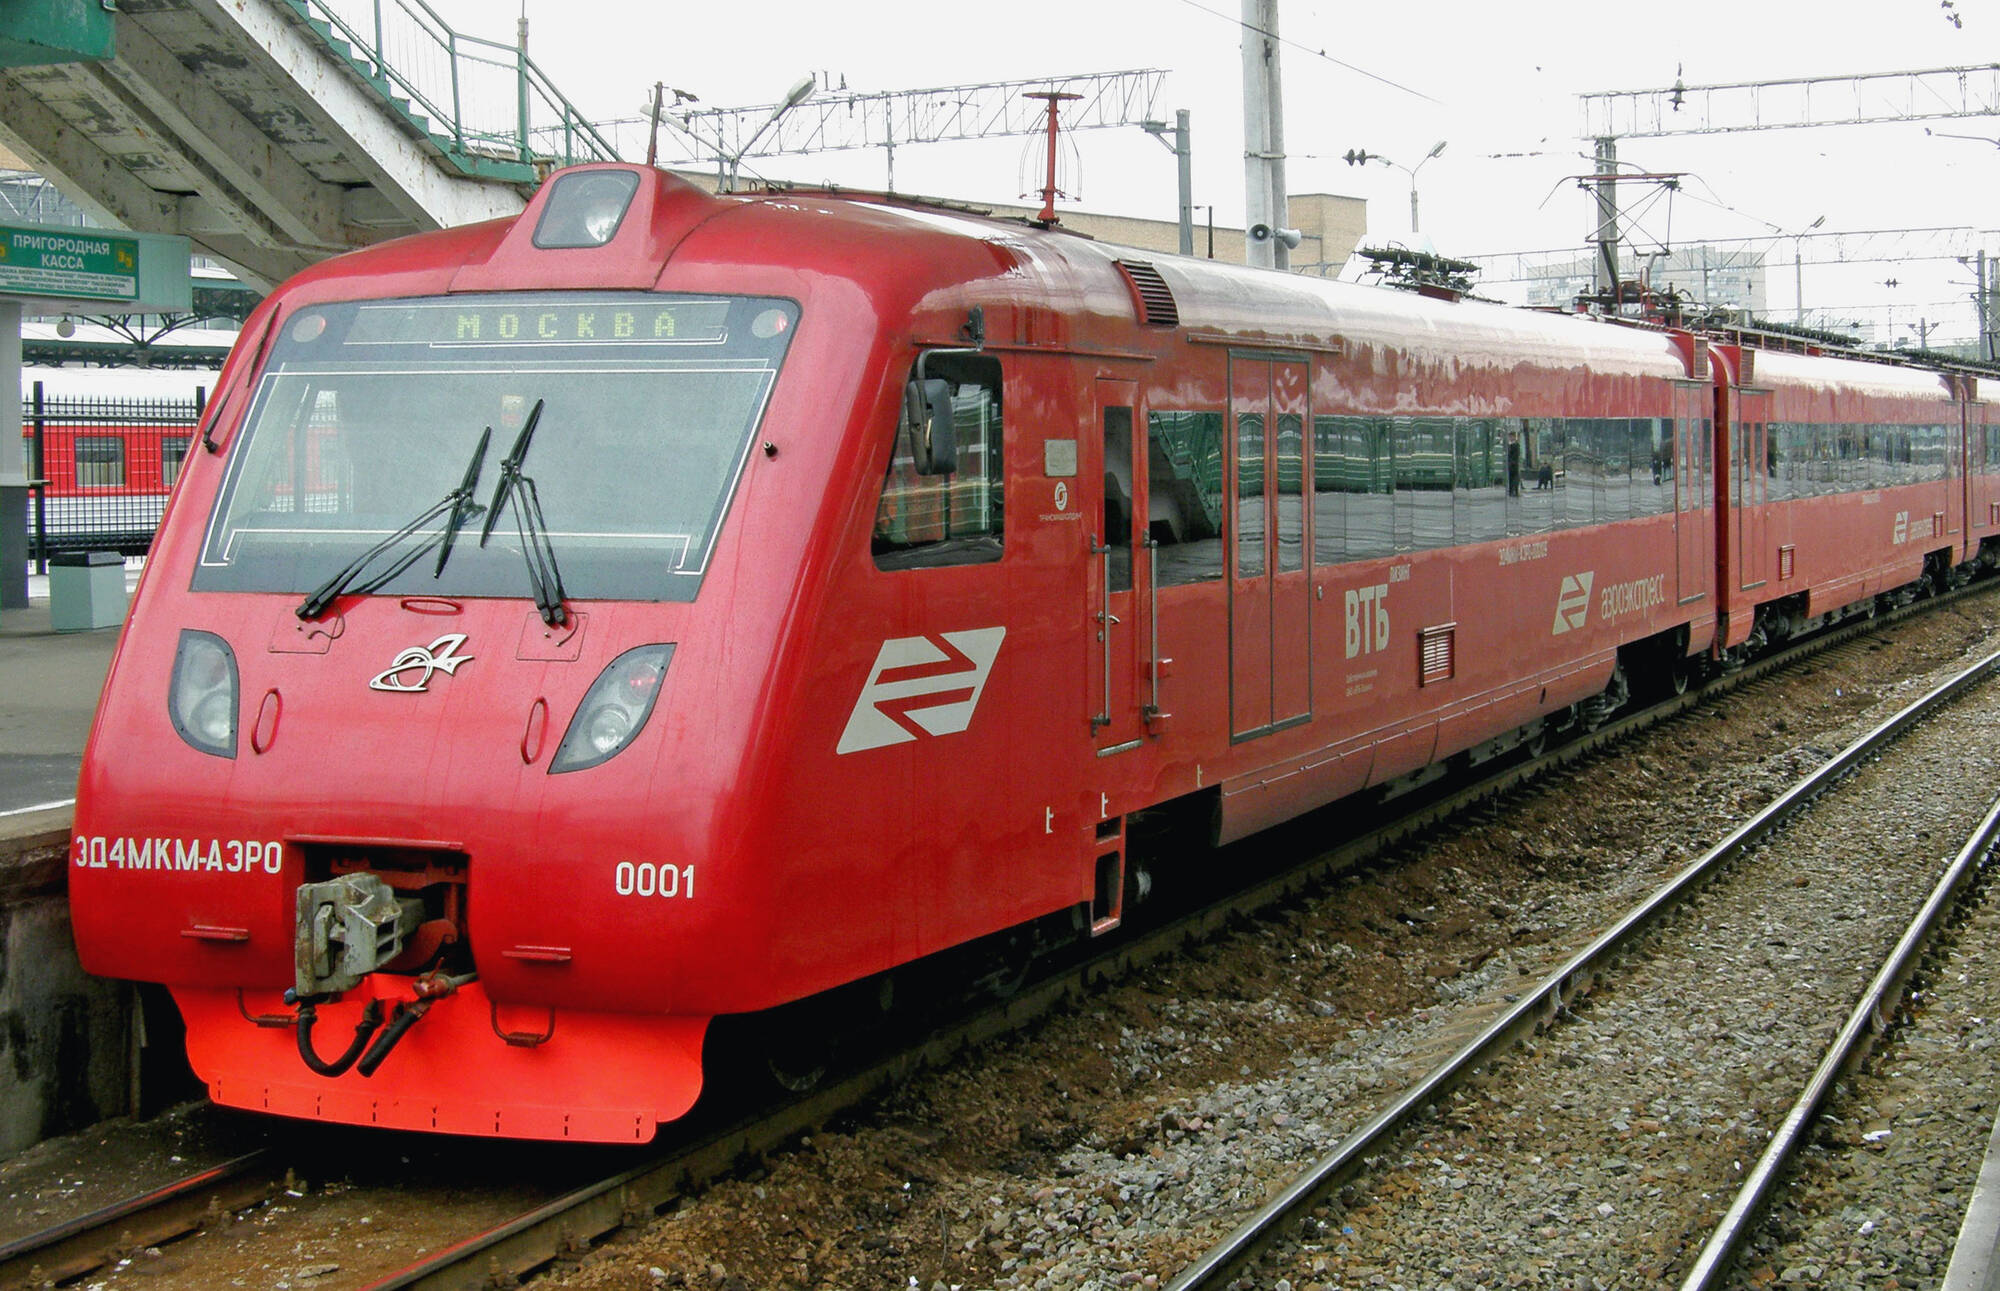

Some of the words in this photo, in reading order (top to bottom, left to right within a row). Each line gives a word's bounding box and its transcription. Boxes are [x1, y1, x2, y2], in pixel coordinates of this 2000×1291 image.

[13, 234, 110, 256] ПРИГОРОДНАЯ
[41, 254, 85, 270] КАССА
[456, 311, 676, 339] МОСКВА
[1345, 583, 1390, 660] ВТБ
[75, 835, 283, 874] ЭД4МКМ-АЭРО
[615, 861, 695, 899] 0001
